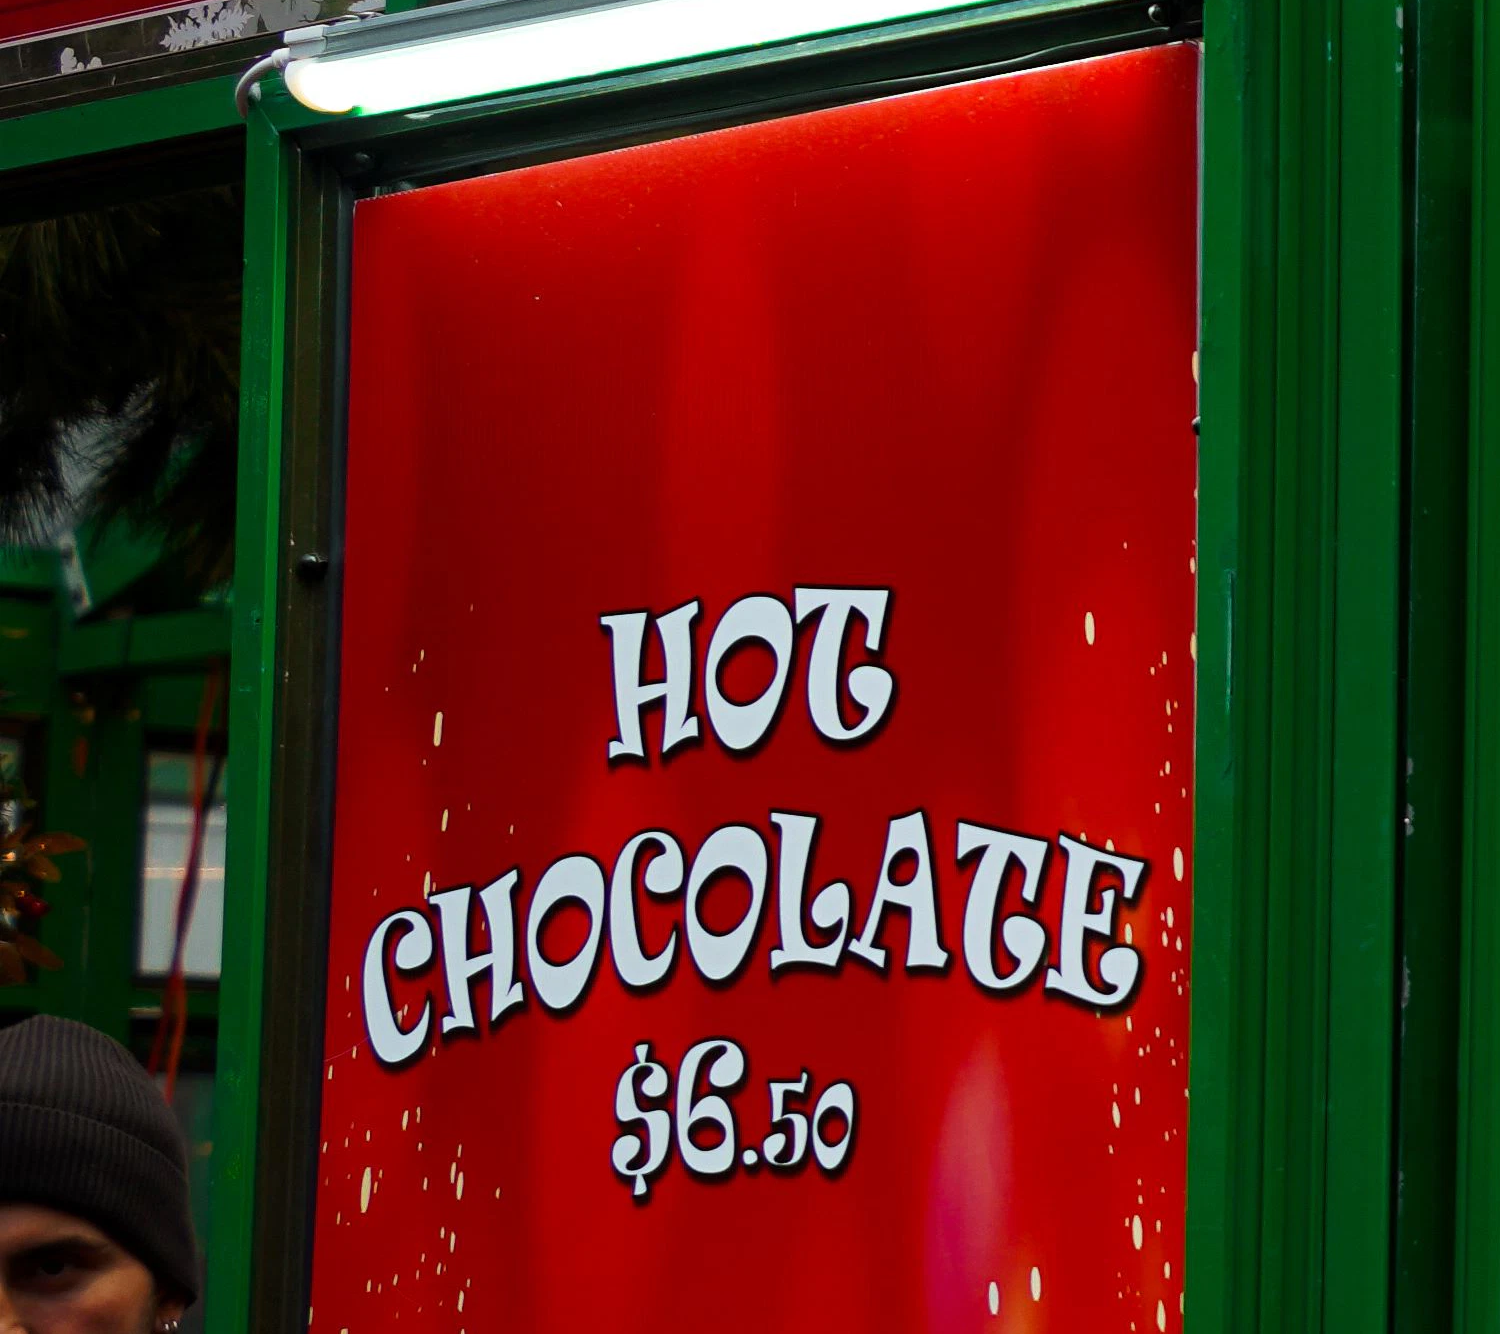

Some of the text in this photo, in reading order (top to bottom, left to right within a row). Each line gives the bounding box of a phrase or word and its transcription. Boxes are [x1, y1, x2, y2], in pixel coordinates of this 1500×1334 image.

[600, 587, 893, 758] HOT
[363, 811, 1144, 1064] CHOCOLATE
[612, 1039, 854, 1196] $6.50
